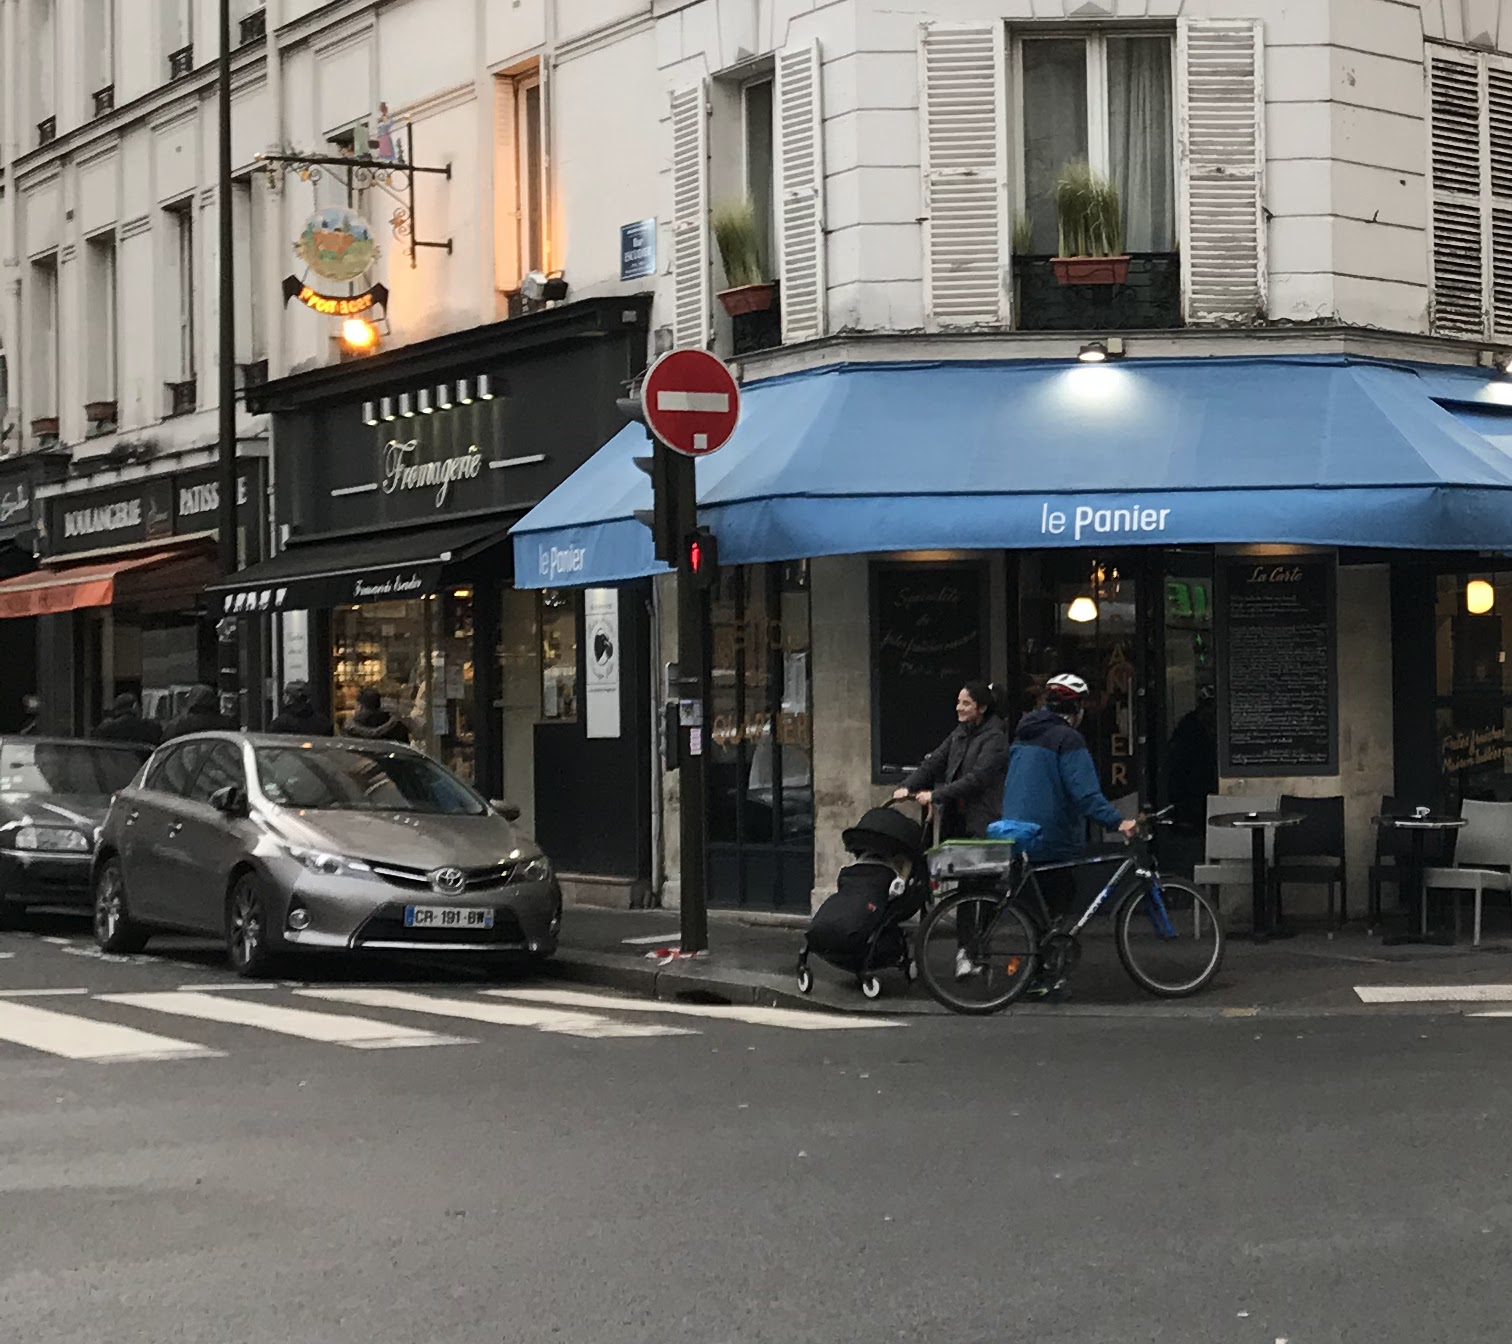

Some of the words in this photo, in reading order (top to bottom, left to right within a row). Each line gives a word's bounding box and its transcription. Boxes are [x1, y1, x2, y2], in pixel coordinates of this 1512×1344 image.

[382, 439, 482, 508] Fromagerie
[64, 498, 142, 538] BOULANGERIE
[179, 476, 248, 516] PATISSE
[1041, 502, 1066, 534] le
[1074, 504, 1171, 541] Panier
[550, 543, 586, 581] Panier
